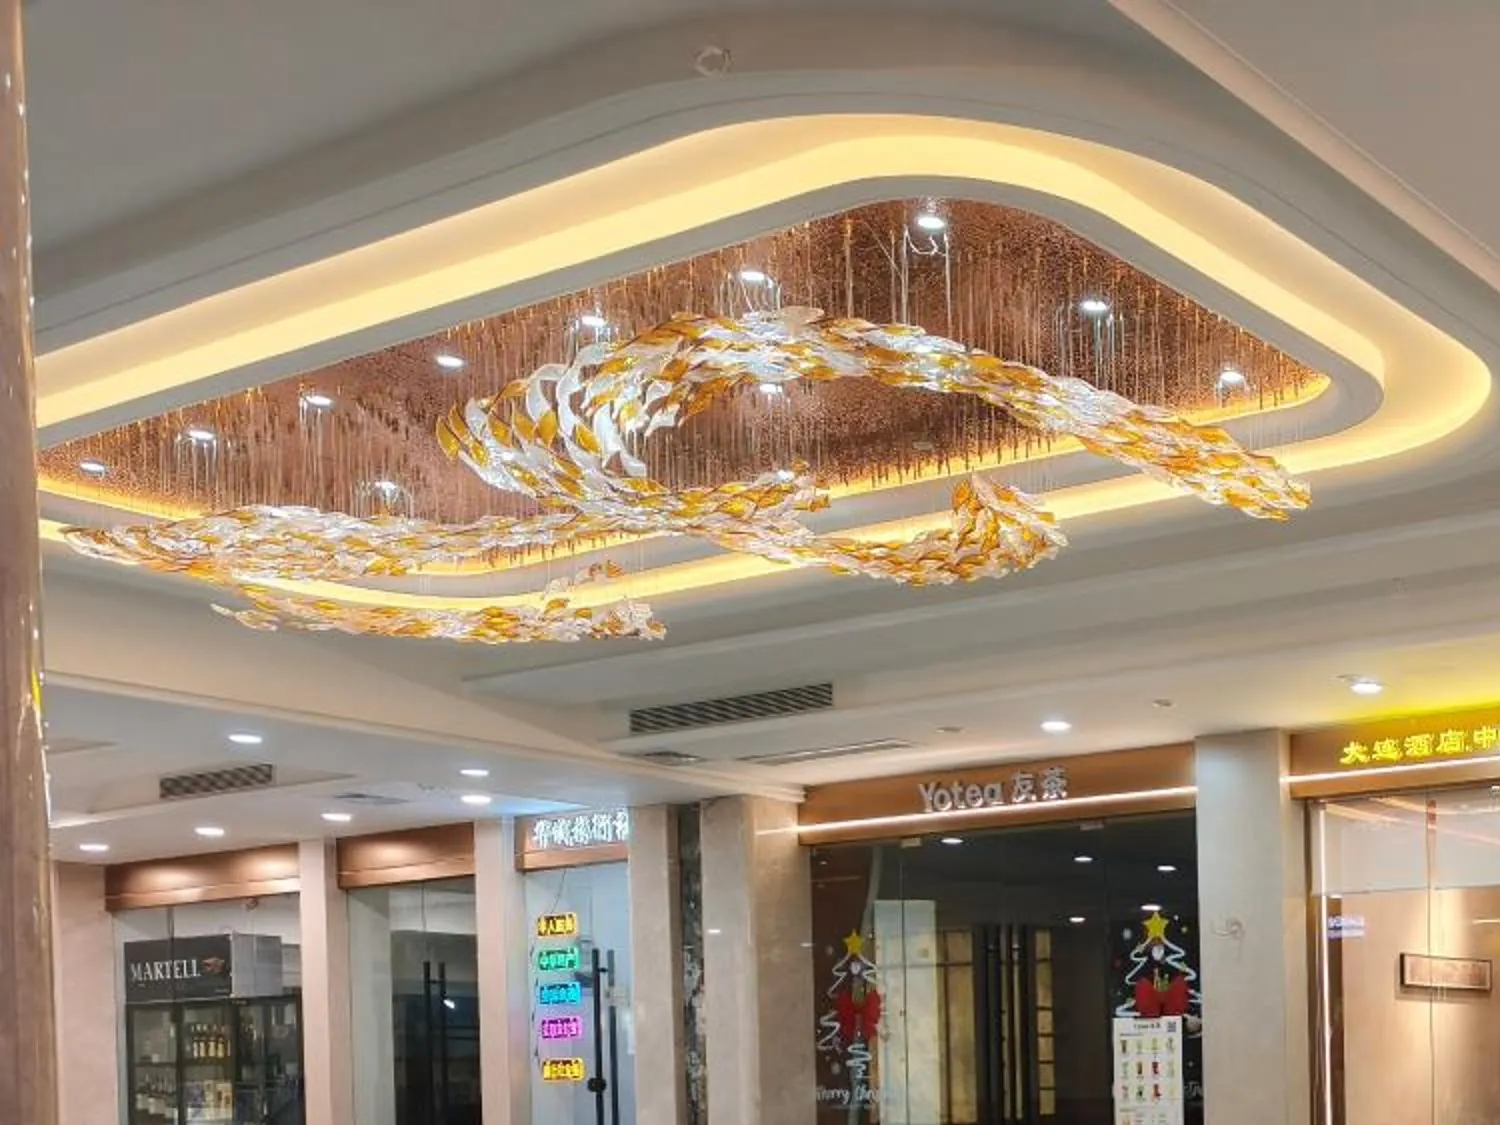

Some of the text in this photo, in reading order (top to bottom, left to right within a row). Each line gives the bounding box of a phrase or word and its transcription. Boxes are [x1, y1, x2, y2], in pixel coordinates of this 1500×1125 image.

[917, 765, 1068, 813] Yotea 友茶
[130, 959, 201, 981] MARTELL
